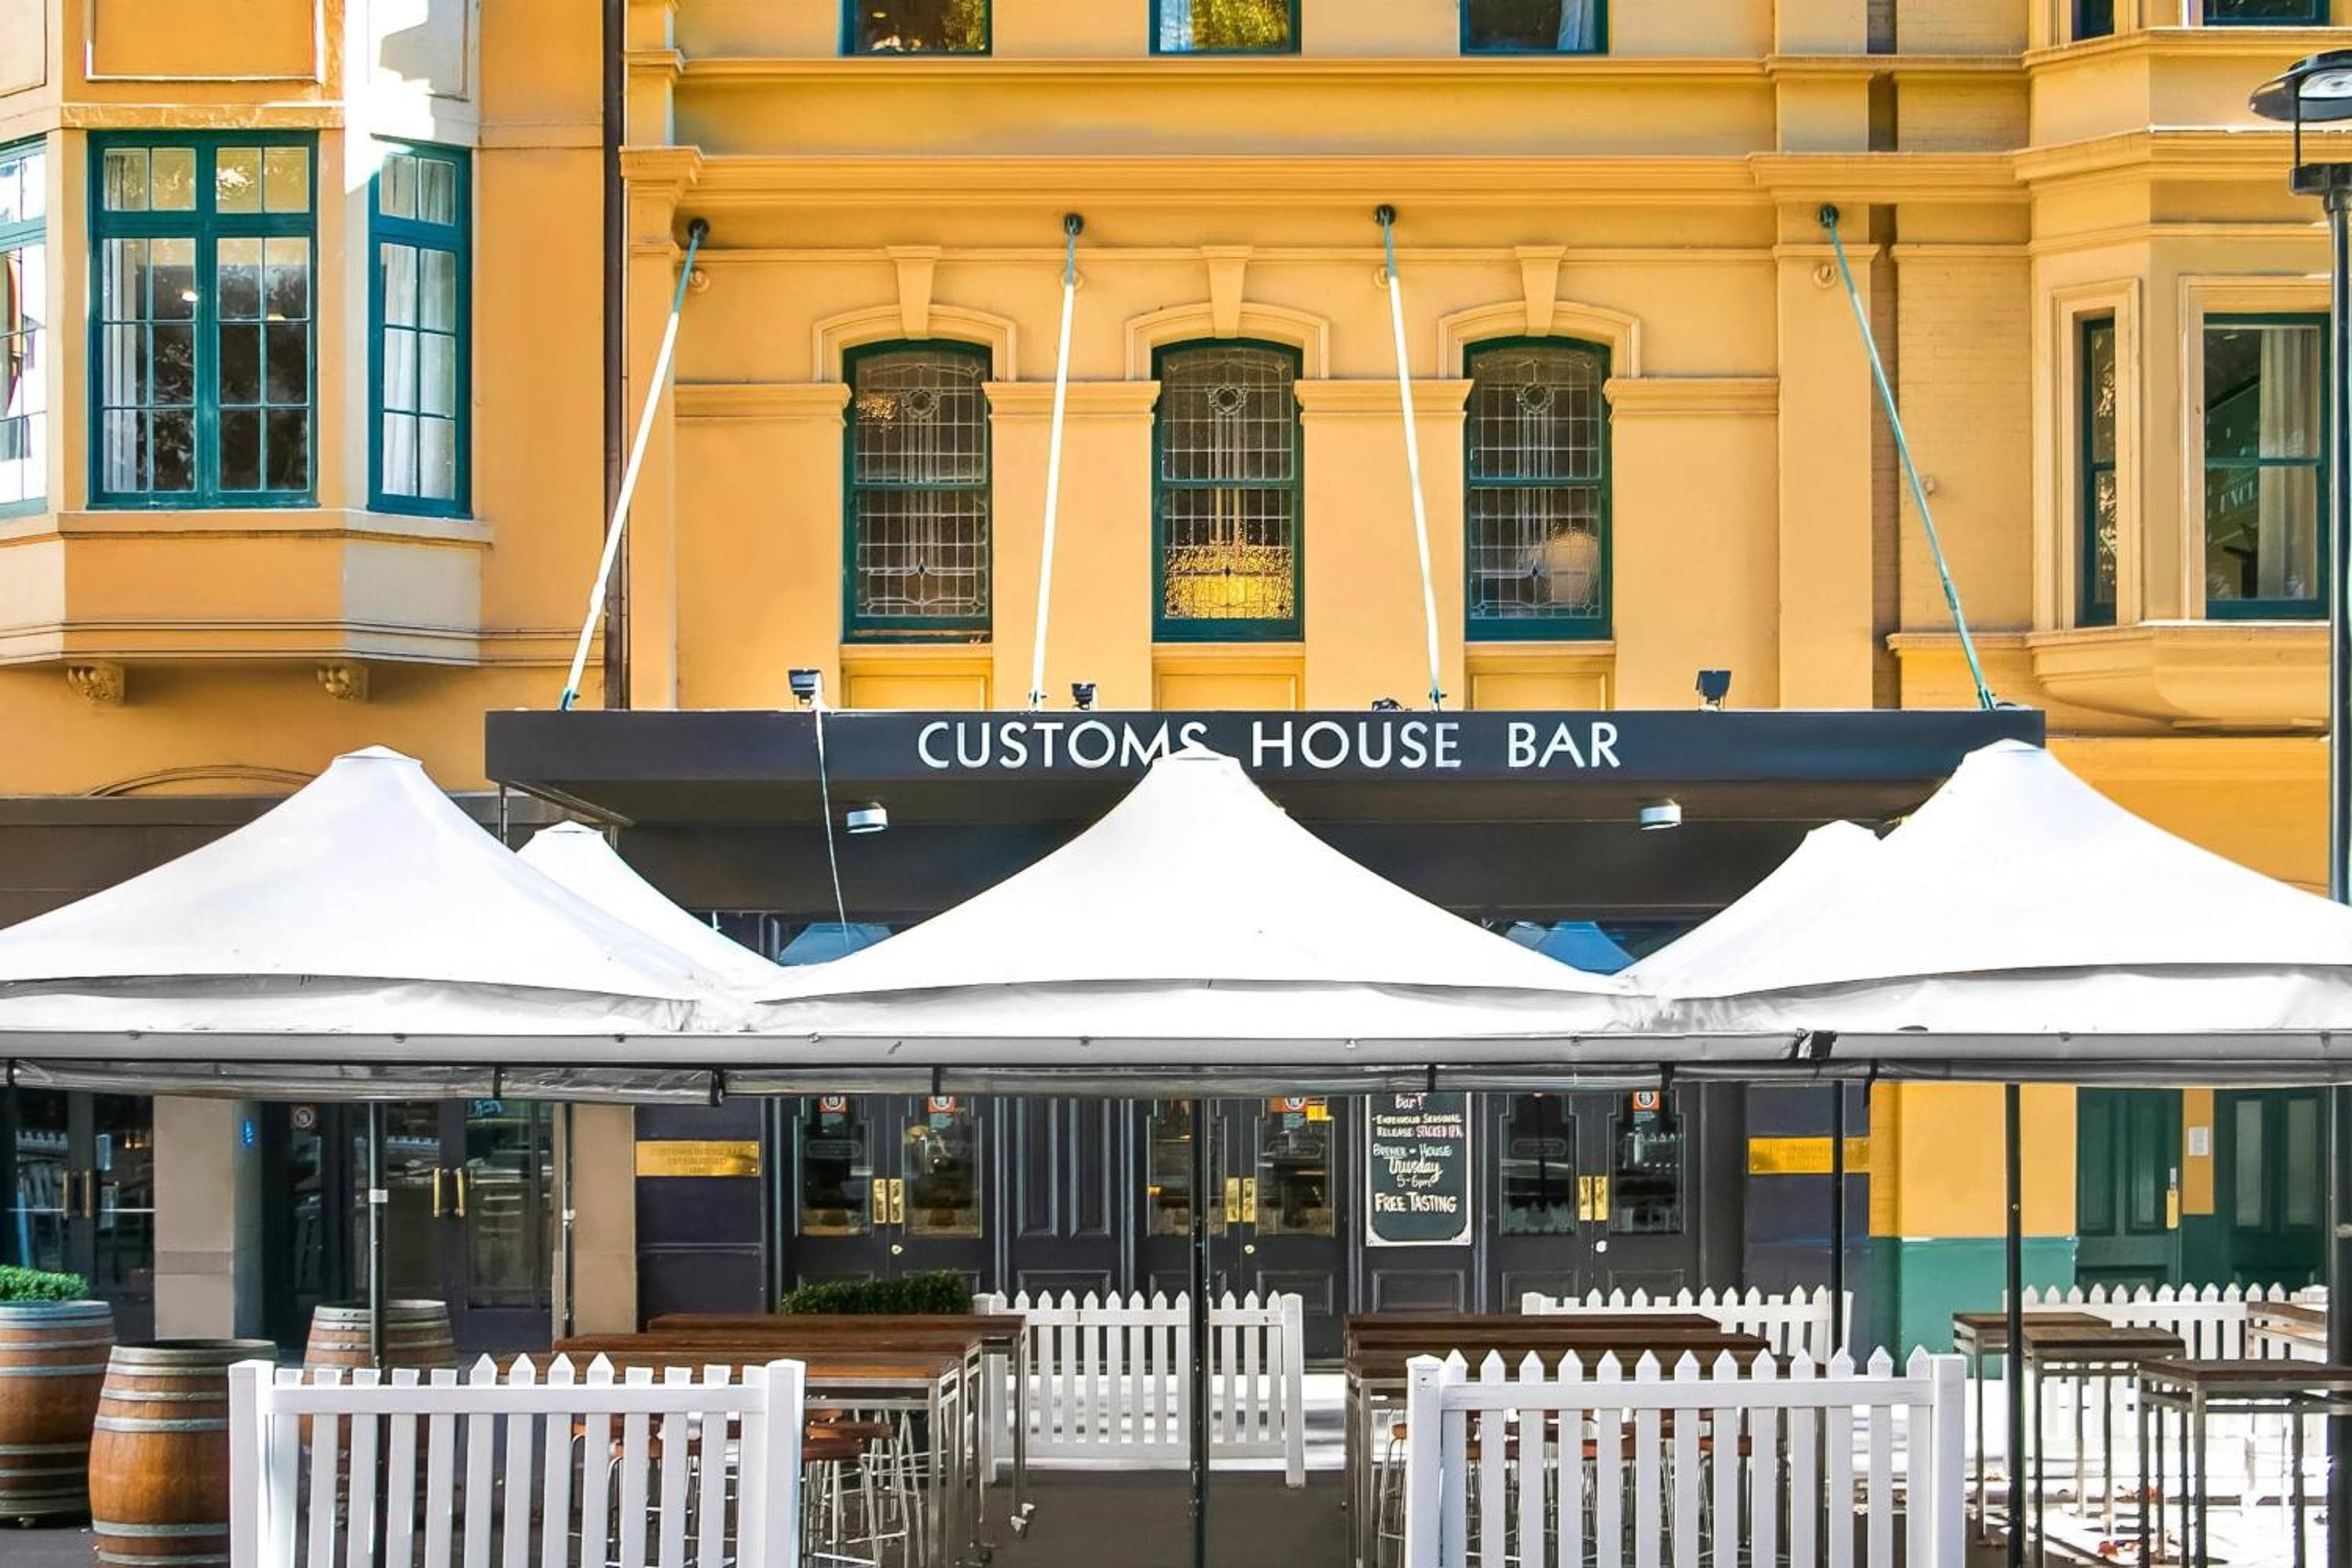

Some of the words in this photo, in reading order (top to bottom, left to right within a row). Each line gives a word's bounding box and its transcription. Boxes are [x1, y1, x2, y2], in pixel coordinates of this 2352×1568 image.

[917, 719, 1207, 768] CUSTOMS
[1251, 720, 1461, 768] HOUSE
[1508, 721, 1621, 768] BAR
[1375, 1192, 1406, 1212] FREE
[1406, 1192, 1457, 1213] TASTING
